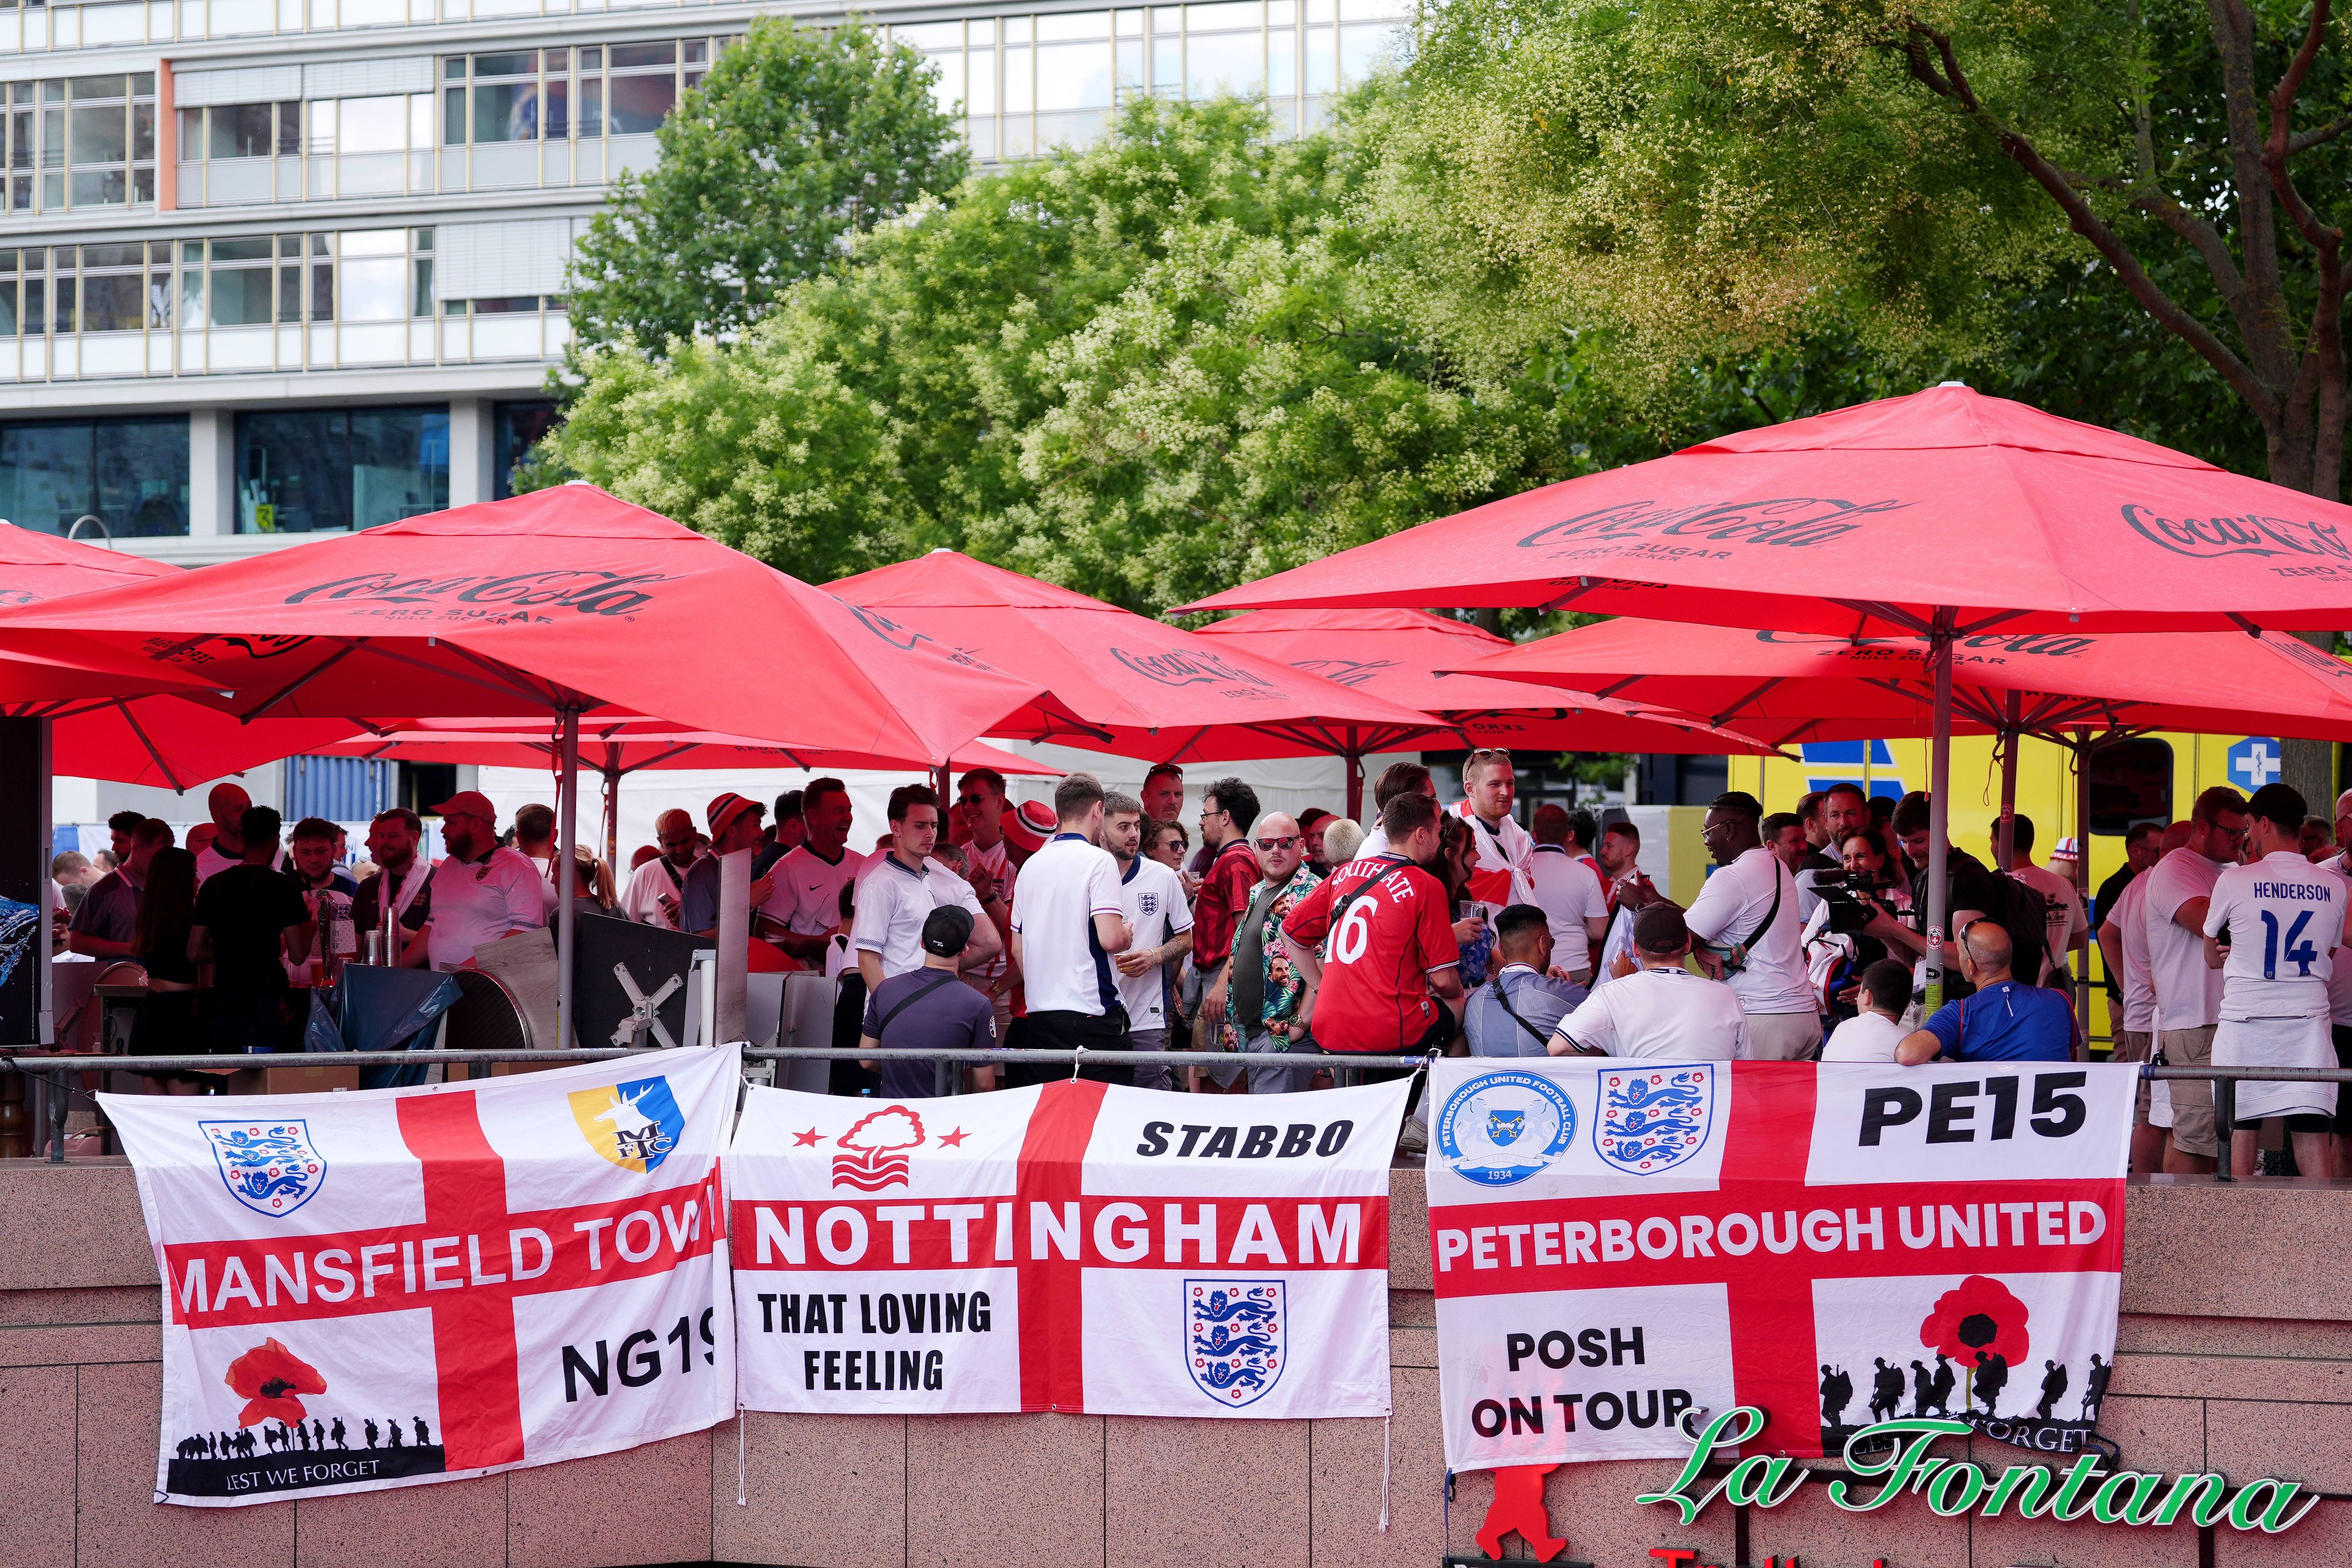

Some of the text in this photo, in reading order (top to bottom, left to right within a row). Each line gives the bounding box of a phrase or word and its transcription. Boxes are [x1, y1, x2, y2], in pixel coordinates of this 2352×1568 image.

[1516, 498, 1925, 548] Coca-Cola
[2121, 504, 2352, 560] Coca-Col
[1545, 543, 1733, 560] ZERO SUGAR
[2269, 566, 2337, 577] ZERO
[285, 570, 691, 616] Coca-Cola
[1907, 648, 2006, 664] SGAR
[1332, 861, 1414, 904] SOUTHATE
[2254, 882, 2331, 903] HENDERSON
[1324, 892, 1378, 965] 16
[2261, 910, 2318, 980] 14
[1443, 1075, 1572, 1148] PETERBOROUGH UNITED FOOTBALL CLUB
[1859, 1072, 2087, 1146] PE15
[1137, 1120, 1353, 1159] STABBO
[1487, 1169, 1513, 1180] 1934
[169, 1185, 715, 1313] MANSFIELD TOW
[755, 1201, 1361, 1265] NOTTINGHAM
[1438, 1201, 2107, 1272] PETERBOROUGH UNITED
[757, 1290, 991, 1334] THAT LOVING
[804, 1350, 943, 1392] FEELING
[1506, 1326, 1646, 1372] POSH
[1472, 1388, 1693, 1438] ON TOUR
[226, 1459, 380, 1490] LEST WE FORGET
[1635, 1406, 2321, 1532] La Fontana
